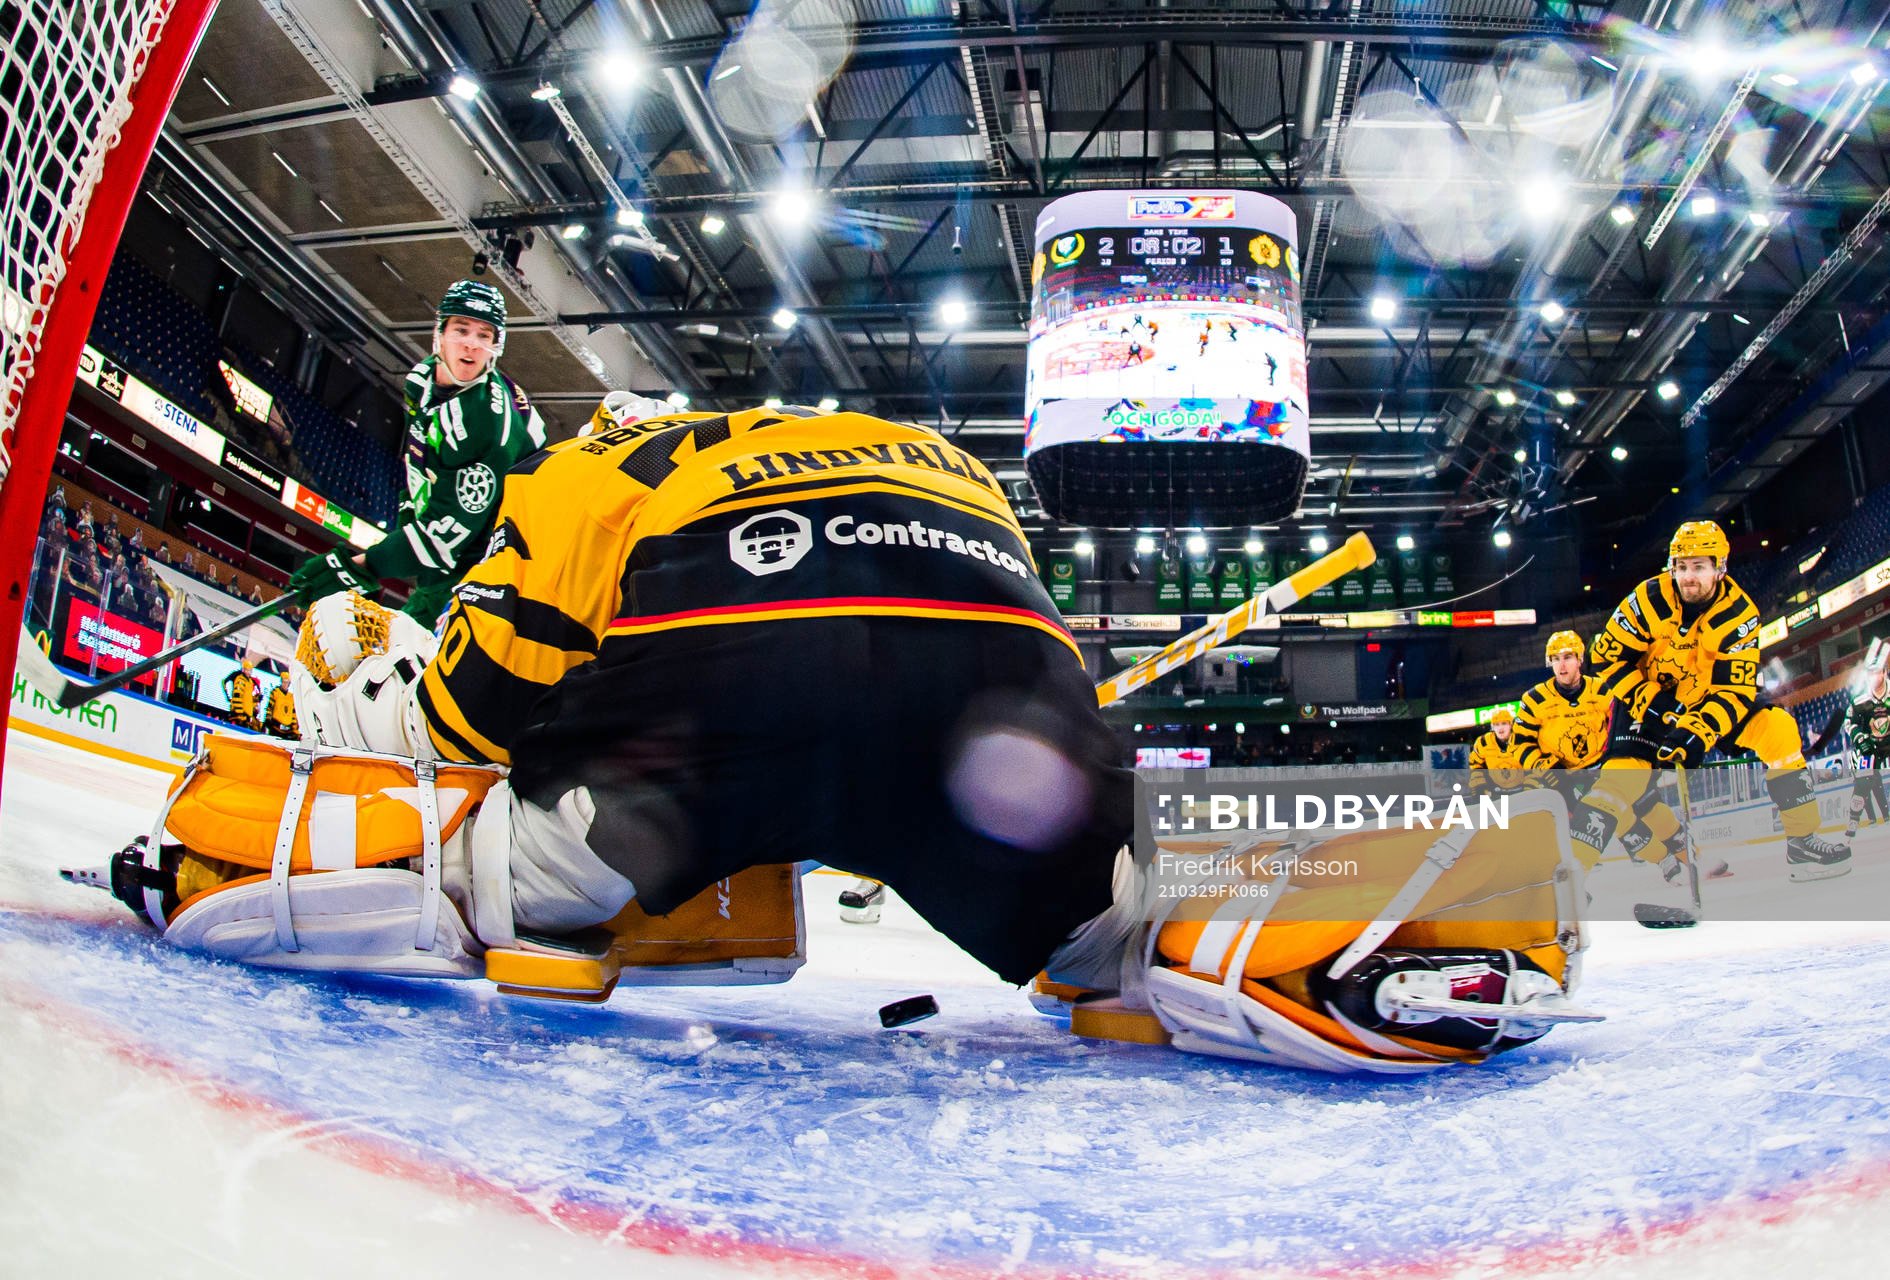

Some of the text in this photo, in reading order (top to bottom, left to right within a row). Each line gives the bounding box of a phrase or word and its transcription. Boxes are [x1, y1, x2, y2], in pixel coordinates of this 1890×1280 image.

[1098, 237, 1114, 255] 2
[1131, 236, 1202, 255] 08:02
[1218, 236, 1234, 255] 1
[163, 403, 198, 436] STENA
[1110, 410, 1221, 426] OCH GODA!
[721, 442, 993, 491] LINDVALL
[824, 515, 1028, 579] Contractor
[1595, 632, 1624, 662] 52
[1730, 660, 1757, 686] 52
[1322, 705, 1388, 716] The Wolfpack
